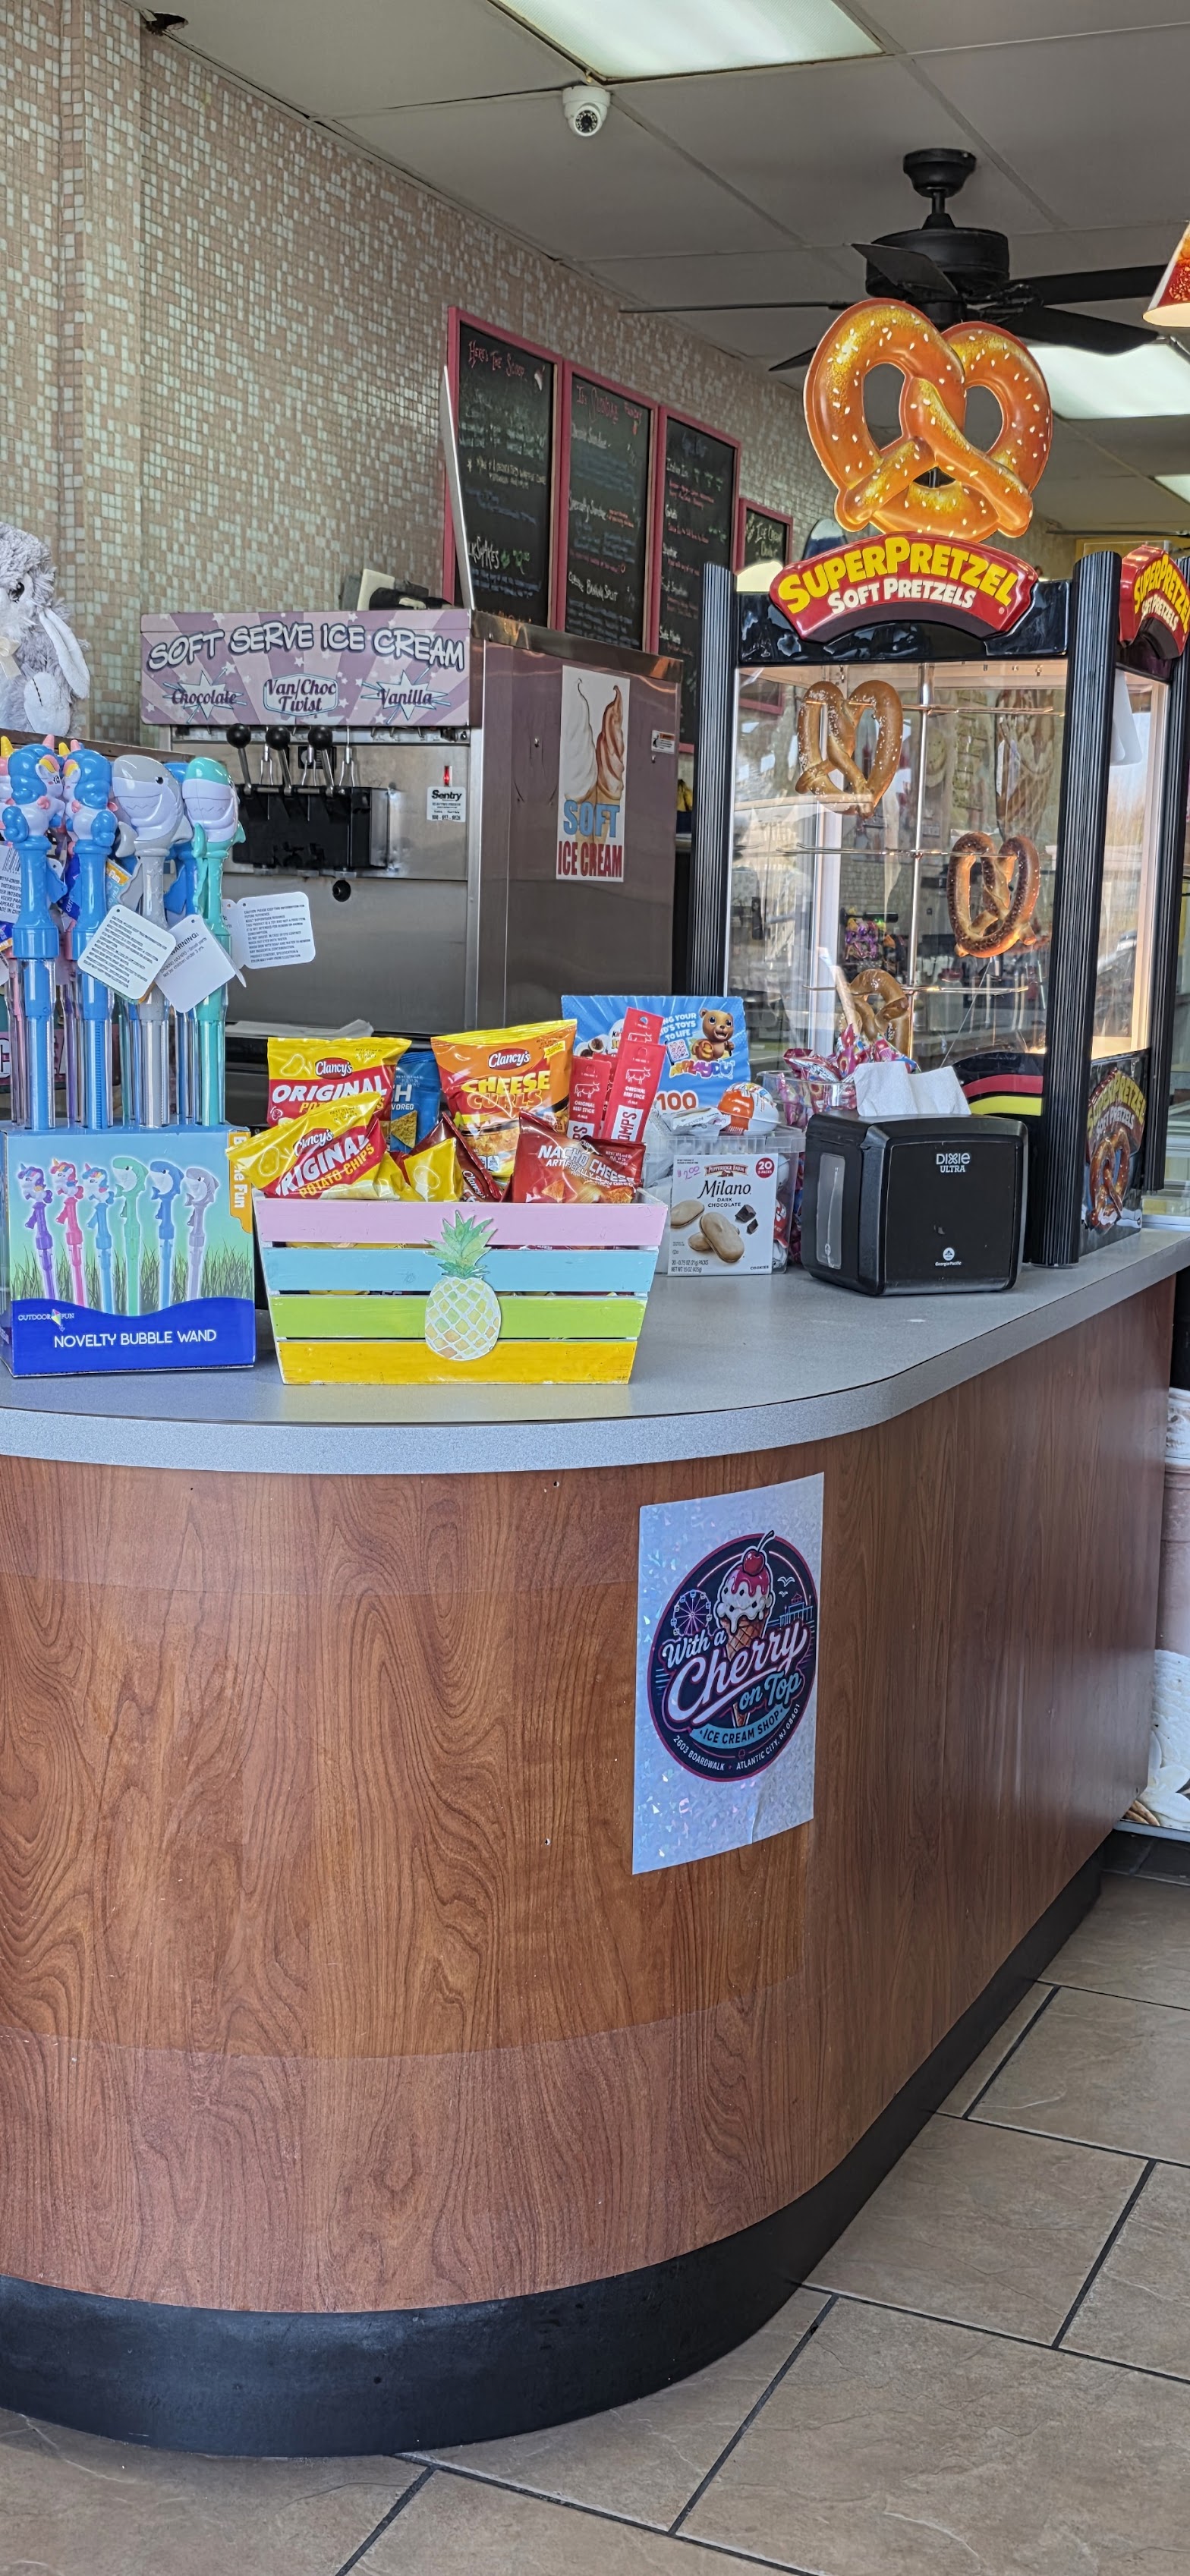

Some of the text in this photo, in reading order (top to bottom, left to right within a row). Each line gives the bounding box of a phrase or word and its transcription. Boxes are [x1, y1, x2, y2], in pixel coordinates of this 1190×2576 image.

[490, 351, 502, 371] THE
[827, 578, 976, 614] SOFT PRETZELS
[1152, 594, 1179, 631] PRETZELS
[147, 620, 465, 672] SOFT SERVE ICE CREAM
[172, 688, 433, 706] Chocolate Vanilla
[266, 679, 336, 700] Van/Choc
[278, 695, 322, 712] Twist
[431, 789, 462, 801] Sentry
[564, 799, 620, 838] SOFT
[558, 841, 622, 877] ICE CREAM
[170, 932, 200, 956] WARNING:
[675, 1012, 697, 1022] YOUR
[675, 1021, 697, 1030] TOYS
[676, 1029, 691, 1038] LIFE
[315, 1060, 354, 1077] Clancy's
[488, 1051, 531, 1068] Clancy's
[272, 1075, 387, 1104] ORIGINAL
[461, 1070, 551, 1094] CHEESE
[467, 1089, 543, 1110] CURLS
[656, 1092, 697, 1110] 100
[343, 1143, 374, 1175] CHIPS
[537, 1145, 590, 1167] NACHO
[759, 1161, 773, 1170] 20
[546, 1159, 593, 1177] ARTIFICIALLY
[589, 1159, 634, 1183] CHEESE
[940, 1164, 965, 1173] ULTRA
[299, 1170, 342, 1198] POTATO
[234, 1185, 247, 1208] Fun
[54, 1329, 217, 1348] NOVELTY BUBBLE WAND
[662, 1629, 726, 1668] With a
[668, 1621, 807, 1724] Cherry
[739, 1671, 802, 1710] on Top
[672, 1703, 800, 1771] 2603 BOARDWALK ATLANTIC CITY, NJ 08401
[703, 1711, 779, 1744] ICE CREAM SHOP
